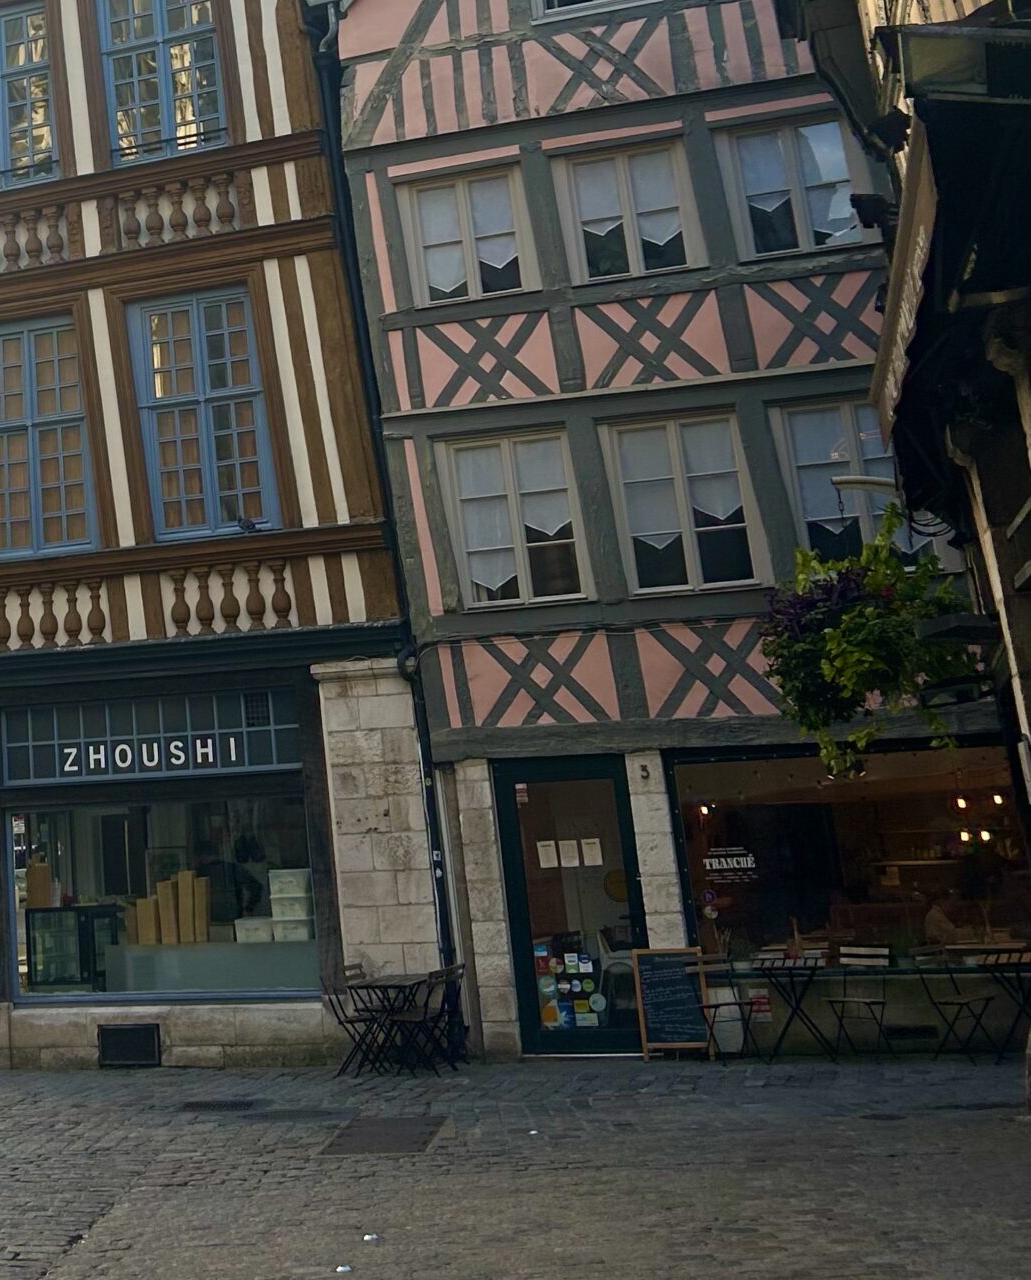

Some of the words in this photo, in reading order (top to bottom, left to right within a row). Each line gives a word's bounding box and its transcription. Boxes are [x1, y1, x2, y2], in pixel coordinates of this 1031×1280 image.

[63, 737, 237, 772] ZHOUSHI
[640, 764, 650, 780] 3
[702, 853, 756, 870] TRANCHÉ
